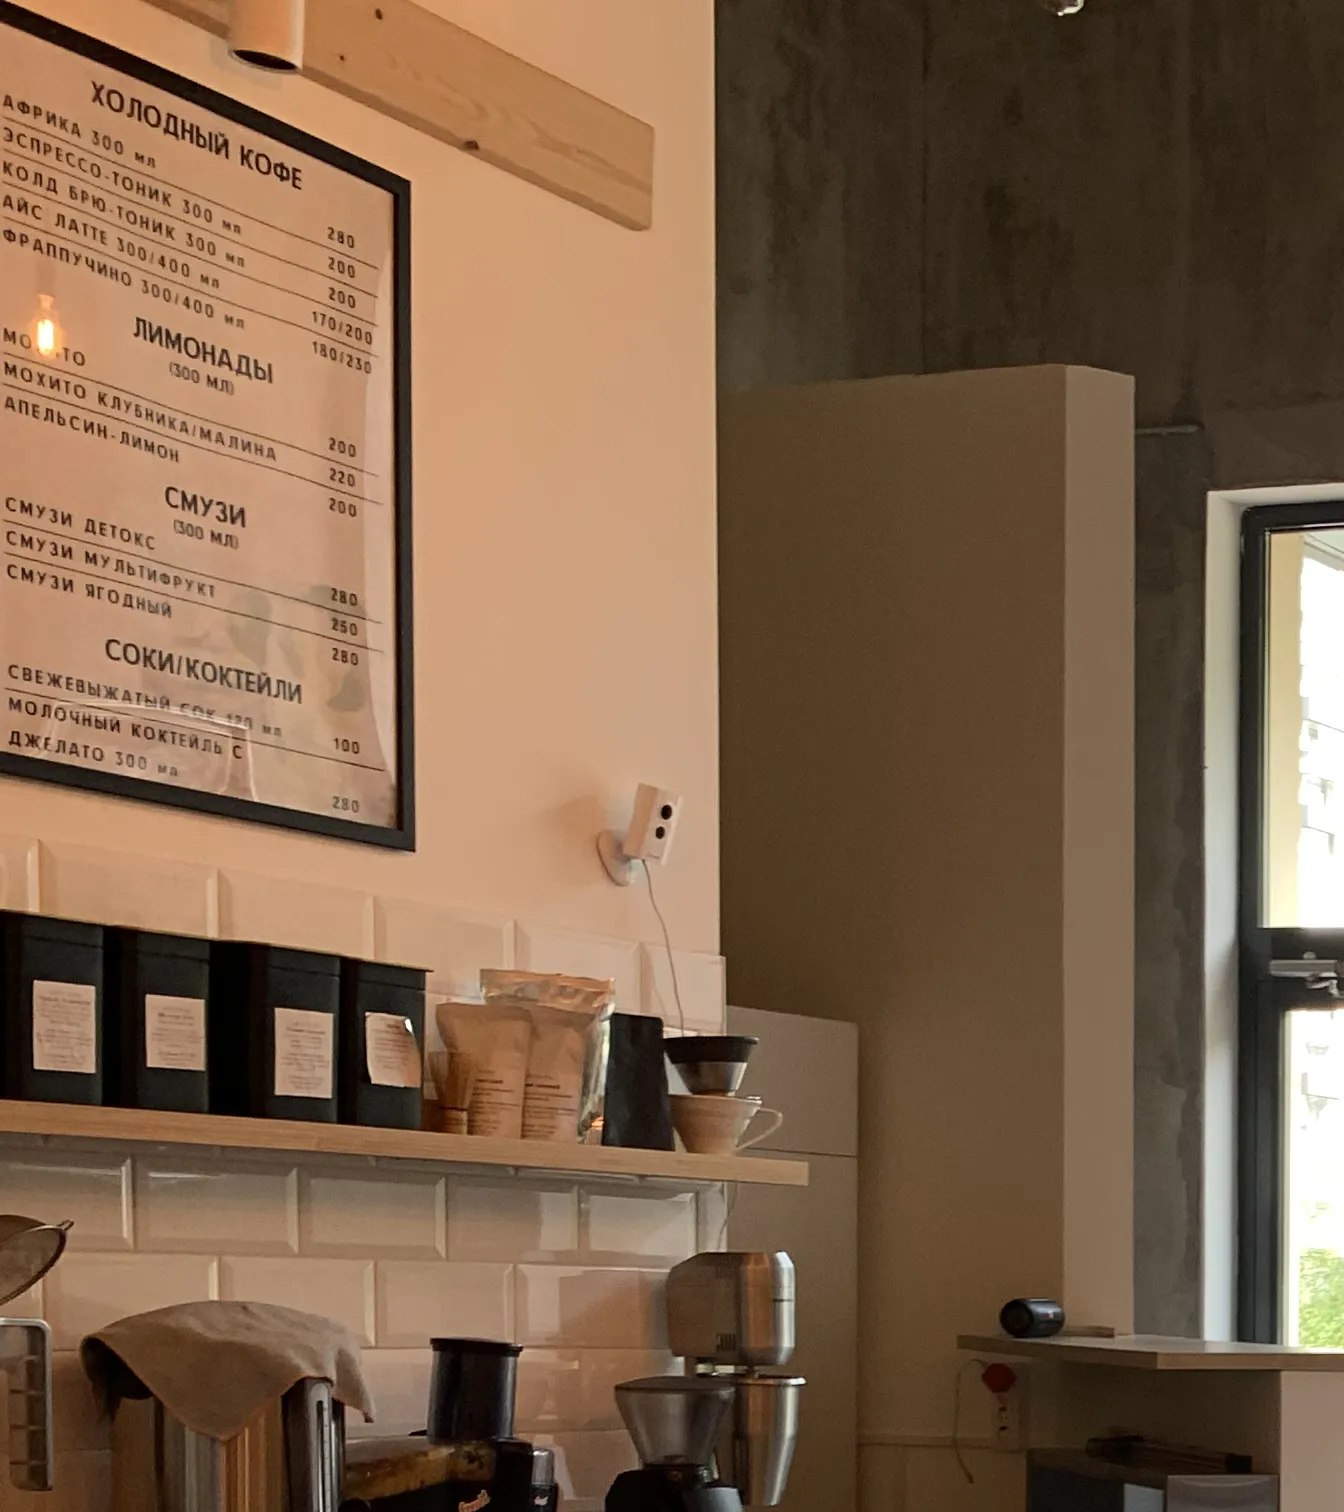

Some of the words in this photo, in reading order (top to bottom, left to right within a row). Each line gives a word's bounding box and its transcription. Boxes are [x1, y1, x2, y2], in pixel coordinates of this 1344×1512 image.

[3, 94, 81, 138] АФРИКА
[91, 130, 124, 155] 300
[135, 152, 156, 168] мл
[327, 227, 355, 248] 280
[91, 80, 230, 160] ХОЛОДНЫЙ
[240, 145, 302, 190] КОФЕ
[3, 127, 172, 207] ЭСПРЕССО-ТОНИК
[183, 199, 213, 223] 300
[222, 220, 241, 234] мл
[328, 256, 356, 278] 200
[3, 161, 58, 194] КОЛД
[69, 186, 176, 240] БРЮ-ТОНИК
[186, 232, 216, 256] 300
[226, 252, 244, 267] мл
[328, 287, 356, 308] 200
[3, 194, 42, 220] АЙС
[55, 213, 108, 246] ЛАТТЕ
[117, 237, 190, 278] 300/400
[200, 274, 220, 289] мл
[312, 311, 373, 345] 170/200
[3, 229, 132, 286] ФРАППУЧИНО
[141, 280, 214, 318] 300/400
[312, 341, 372, 374] 180/230
[3, 328, 86, 366] МОТО
[329, 437, 356, 457] 200
[133, 317, 273, 383] ЛИМОНАДЫ
[169, 362, 200, 385] (300
[4, 361, 86, 399] МОХИТО
[98, 391, 276, 461] КЛУБНИКА/МАЛИНА
[329, 467, 355, 487] 220
[4, 396, 180, 463] АПЕЛЬСИН-ЛИМОН
[329, 497, 357, 517] 200
[5, 497, 73, 527] СМУЗИ
[84, 518, 155, 550] ДЕТОКС
[331, 588, 358, 606] 280
[164, 486, 246, 528] СМУЗИ
[173, 519, 204, 540] (300
[6, 531, 73, 560] СМУЗИ
[85, 551, 215, 598] МУЛЬТИФРУКТ
[331, 617, 358, 636] 250
[7, 564, 74, 593] СМУЗИ
[85, 583, 172, 618] ЯГОДНЫЙ
[332, 647, 359, 666] 280
[8, 664, 170, 709] СВЕЖЕВЫЖАТЫЙ
[334, 737, 360, 754] 100
[105, 639, 302, 704] СОКИ/КОКТЕЙЛИ
[8, 730, 104, 762] ДЖЕЛАТО
[115, 751, 147, 770] 300
[333, 796, 360, 813] 280
[9, 697, 121, 734] МОЛОЧНЫЙ
[131, 723, 222, 755] КОКТЕЙЛЬ
